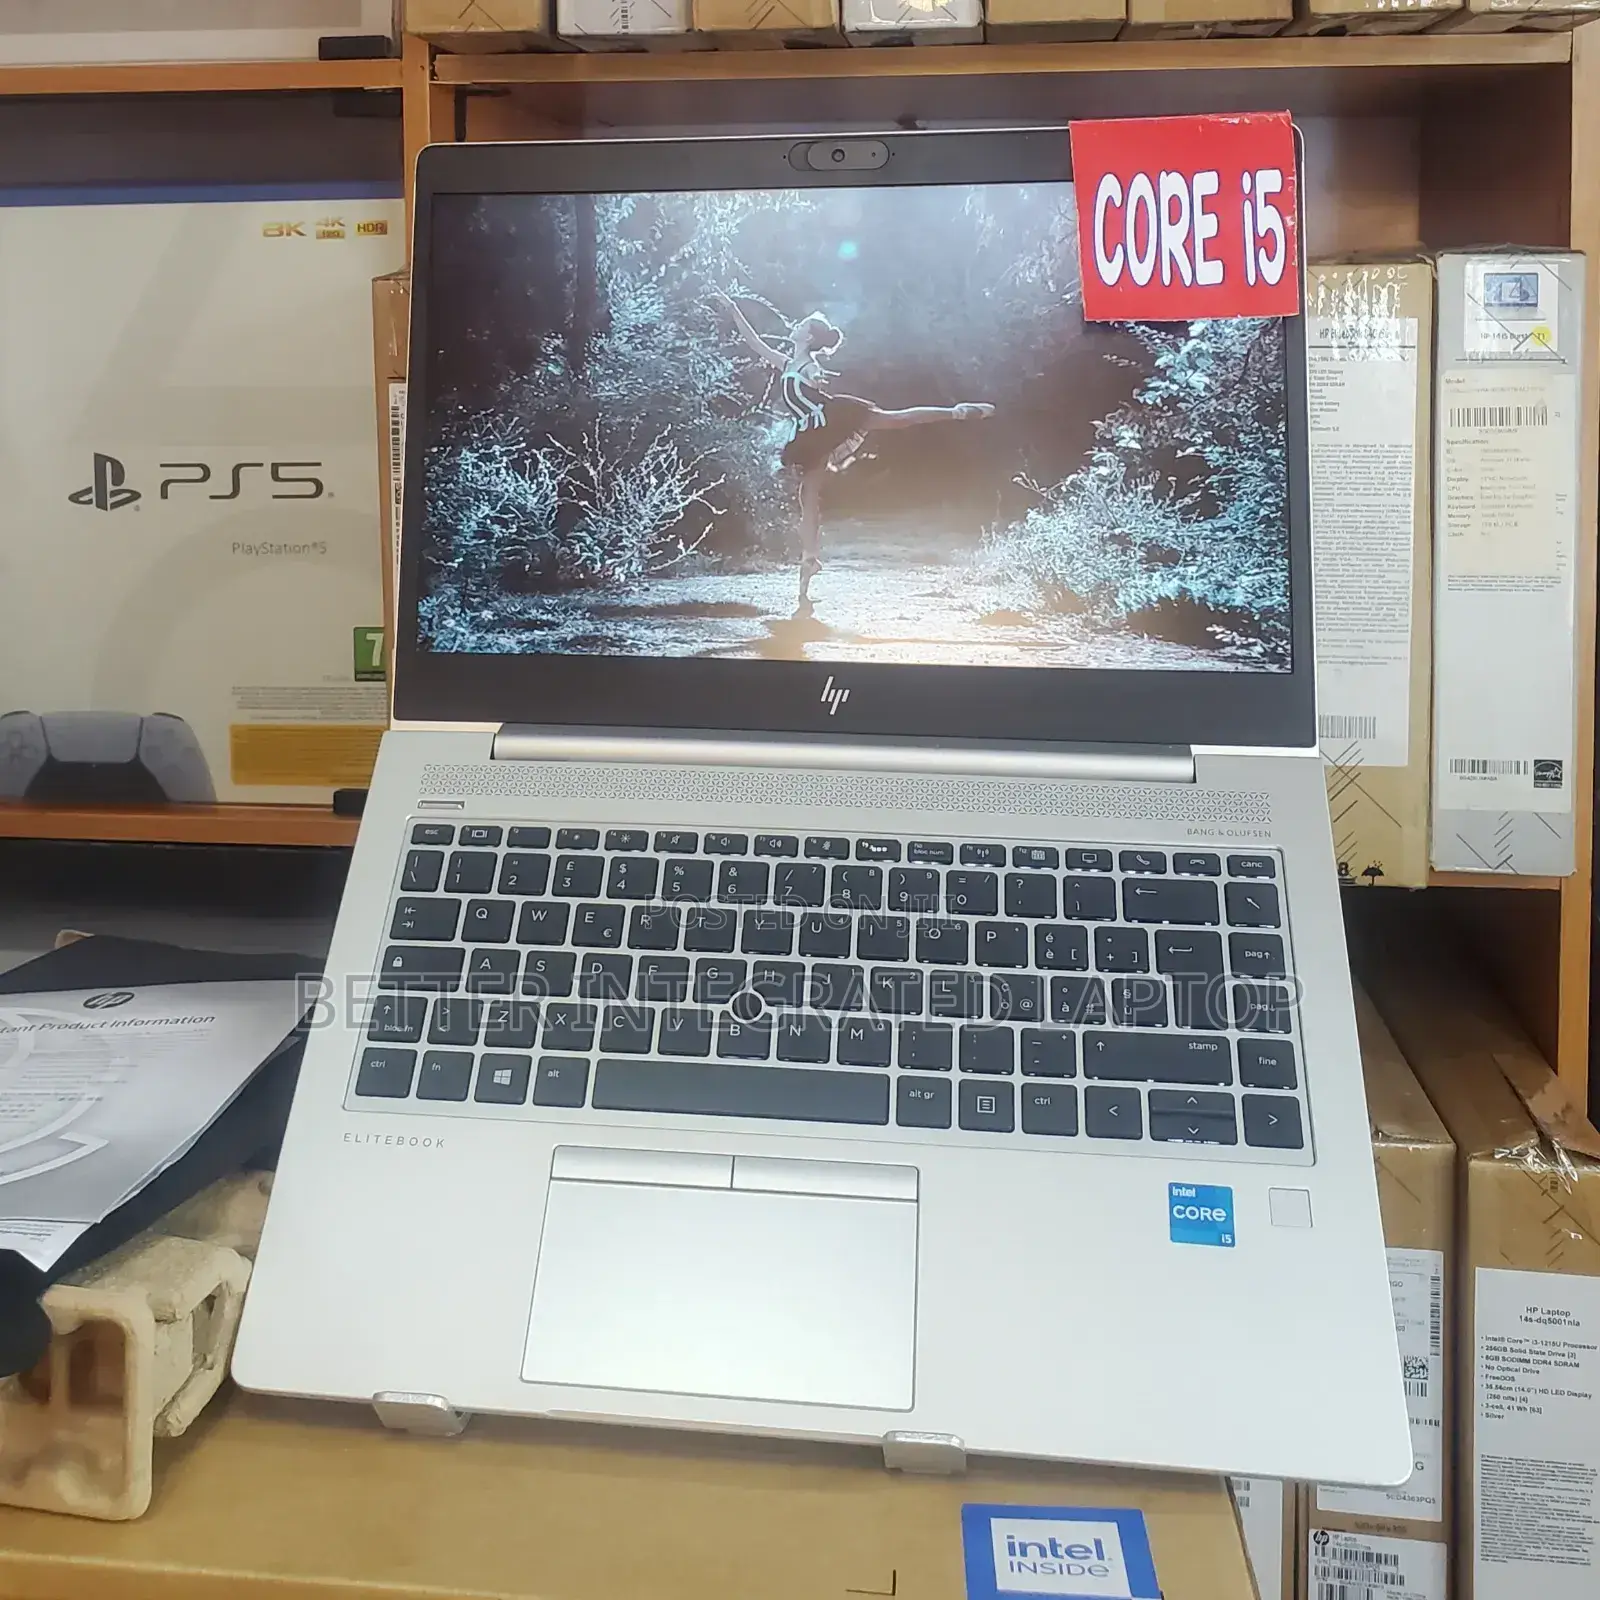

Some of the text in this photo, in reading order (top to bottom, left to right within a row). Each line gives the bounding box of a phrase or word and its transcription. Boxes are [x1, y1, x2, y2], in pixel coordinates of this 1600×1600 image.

[262, 221, 307, 237] 8K
[357, 222, 385, 233] HDR
[1094, 168, 1286, 287] CORE i5
[366, 633, 384, 666] 7
[820, 676, 850, 715] hp
[1187, 828, 1215, 836] BANG
[1226, 829, 1272, 838] OLUFSEN
[868, 868, 875, 877] 8
[508, 876, 517, 886] 2
[562, 877, 571, 888] 3
[616, 879, 626, 890] 4
[671, 882, 681, 892] 5
[727, 883, 737, 894] 6
[784, 886, 793, 896] 7
[842, 888, 851, 899] 8
[899, 891, 908, 902] 9
[476, 908, 489, 920] Q
[531, 910, 548, 921] W
[584, 911, 595, 923] E
[640, 915, 650, 926] R
[697, 917, 706, 928] T
[755, 919, 765, 930] Y
[603, 928, 612, 938] €
[811, 922, 823, 933] U
[986, 931, 997, 943] P
[480, 958, 491, 970] A
[536, 960, 546, 972] S
[592, 963, 603, 974] D
[648, 965, 658, 976] F
[707, 967, 718, 978] G
[764, 970, 775, 982] H
[822, 973, 831, 985] J
[882, 976, 893, 989] K
[942, 981, 951, 992] L
[1019, 999, 1034, 1011] @
[498, 1011, 509, 1023] Z
[554, 1013, 567, 1025] X
[613, 1015, 625, 1027] C
[38, 1020, 109, 1031] Product
[109, 1015, 217, 1028] Information
[672, 1018, 683, 1031] V
[730, 1024, 741, 1036] B
[789, 1025, 801, 1036] N
[850, 1028, 863, 1041] M
[1188, 1042, 1218, 1051] stamp
[370, 1060, 386, 1068] ctrl
[1258, 1057, 1277, 1066] fine
[431, 1063, 441, 1072] fn
[547, 1069, 560, 1078] alt
[909, 1089, 935, 1100] alt gr
[1034, 1097, 1051, 1105] ctrl
[344, 1132, 445, 1149] ELITEBOOK
[1172, 1186, 1196, 1198] intel
[1526, 1306, 1571, 1318] HP Laptop
[1562, 1342, 1598, 1351] Processor
[1509, 1347, 1527, 1355] Solid
[1548, 1350, 1566, 1358] Drive
[1554, 1360, 1580, 1368] SDRAM
[1522, 1367, 1540, 1375] Drive
[1485, 1374, 1516, 1382] FreeDOS
[1567, 1390, 1593, 1399] Display
[1485, 1412, 1505, 1420] Silver
[1006, 1535, 1106, 1561] intel
